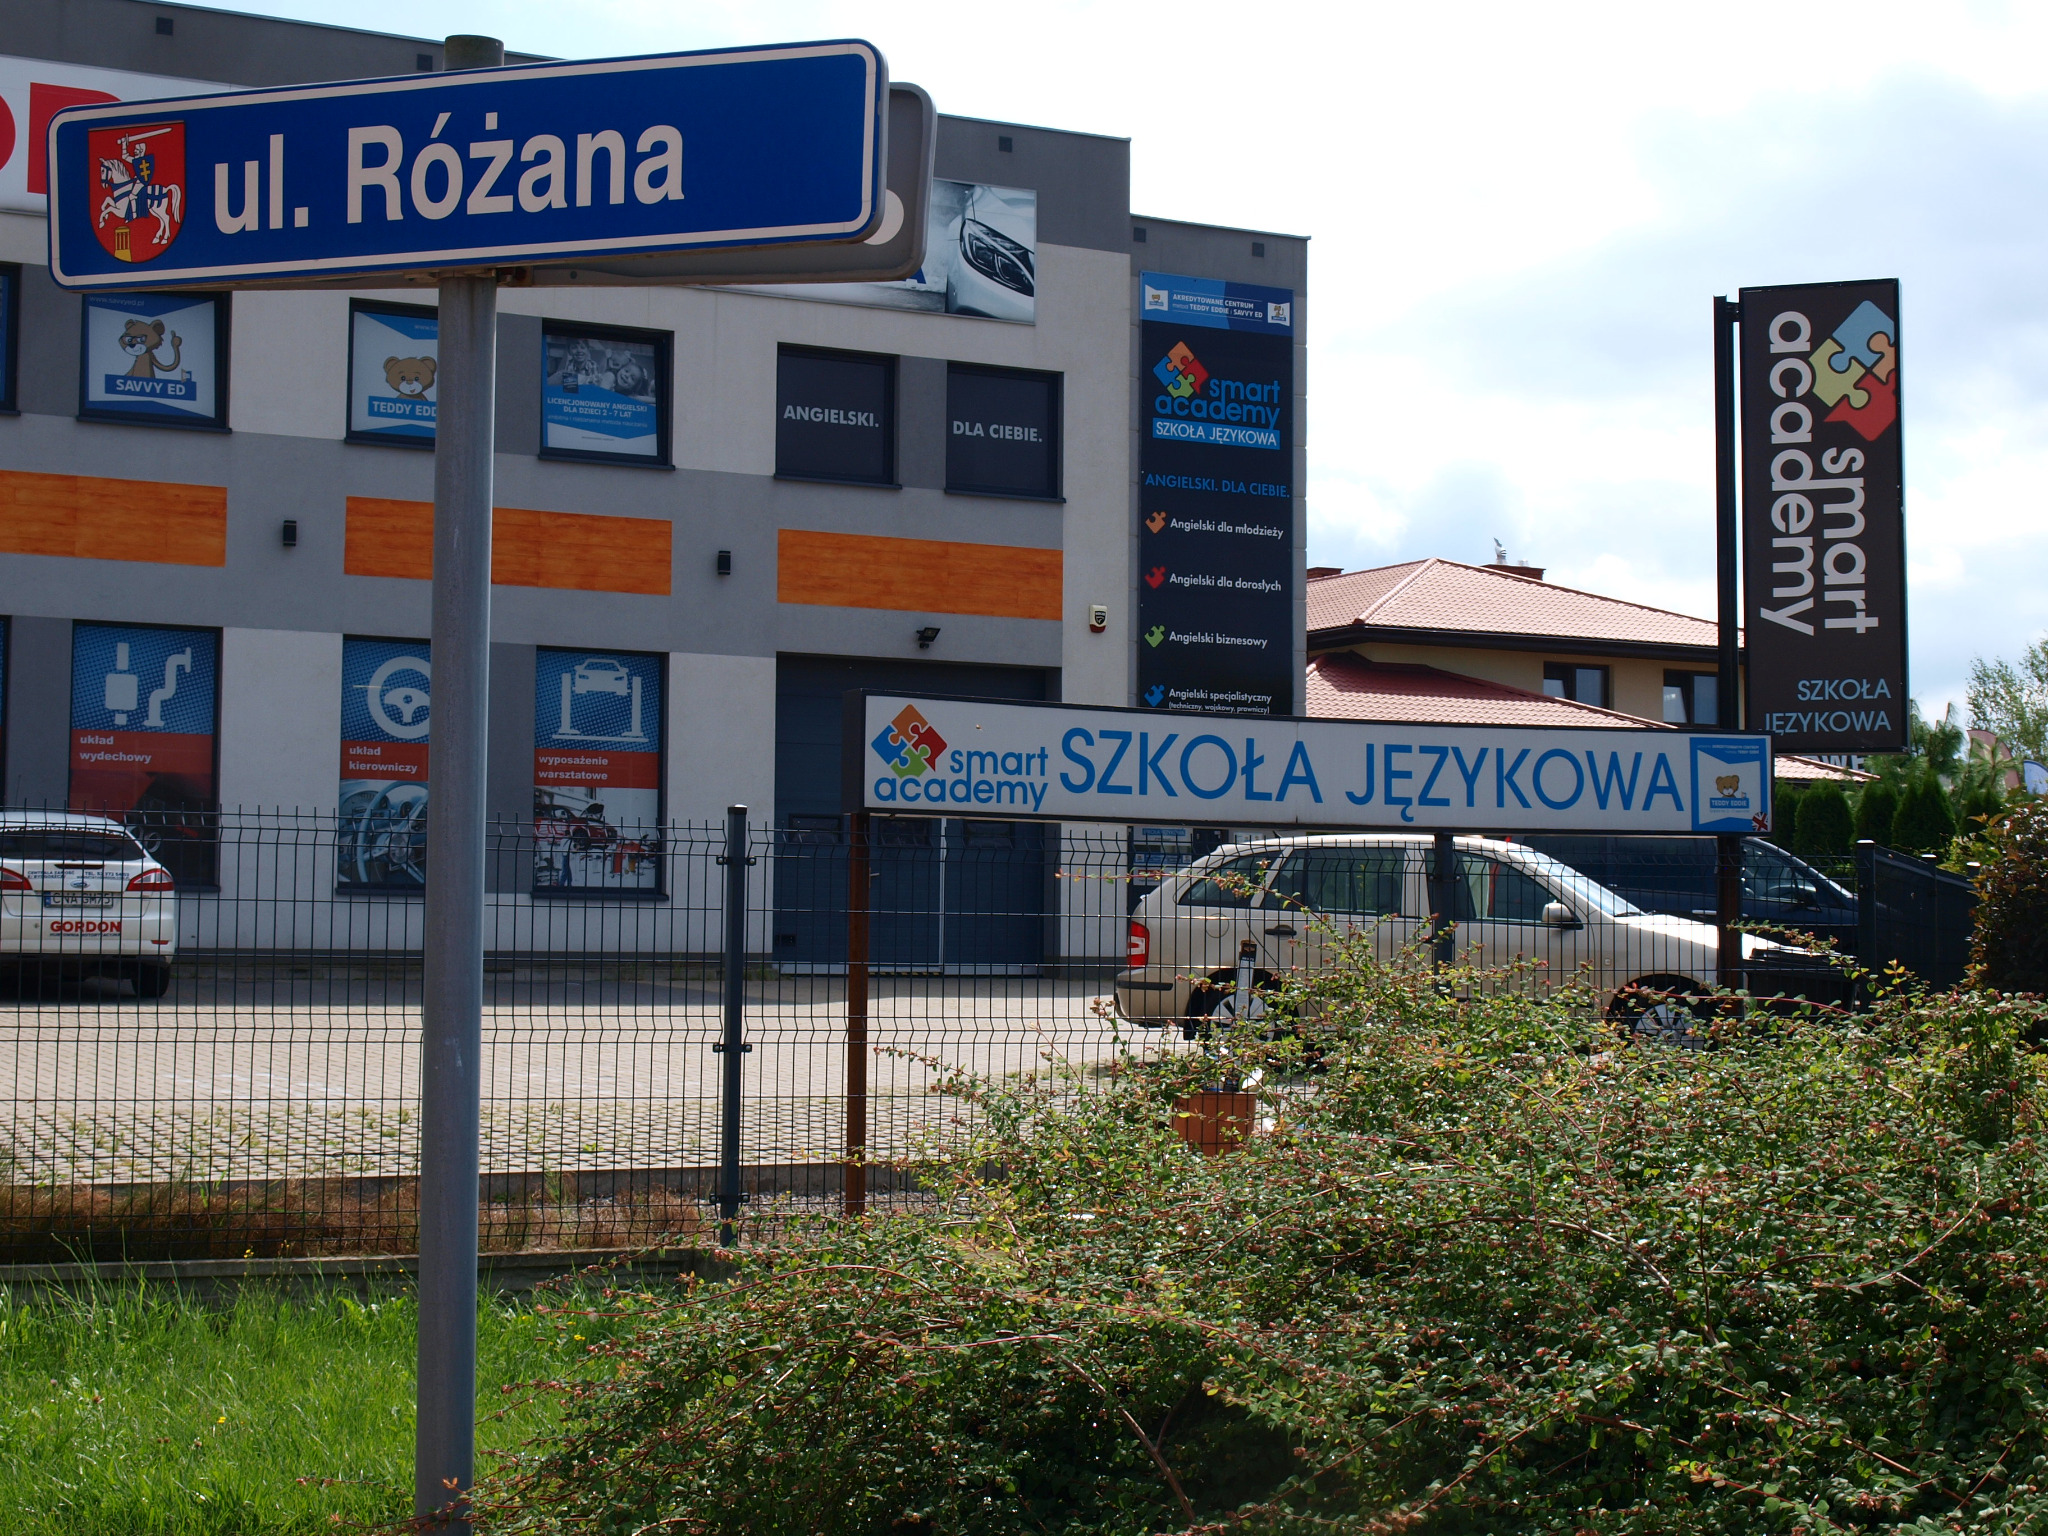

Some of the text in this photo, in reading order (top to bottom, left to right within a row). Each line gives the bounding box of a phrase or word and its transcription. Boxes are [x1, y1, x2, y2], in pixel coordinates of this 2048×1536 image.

[214, 134, 309, 234] ul.
[347, 112, 684, 223] Różana
[1172, 294, 1254, 310] AKREDYTOWANE CENTRUM
[1190, 304, 1209, 313] TEDDY
[1211, 306, 1229, 315] EDDIE
[1233, 309, 1254, 318] SAVVY
[1254, 311, 1263, 319] ED
[116, 379, 185, 396] SAVVY ED
[1209, 378, 1281, 404] smart
[372, 401, 412, 415] TEDDY
[547, 397, 647, 413] LICENCJONOWANY ANGIELSKI
[563, 406, 578, 414] DLA
[579, 408, 601, 416] DZIECI
[1154, 394, 1281, 430] academy
[783, 405, 880, 428] ANGIELSKI.
[953, 420, 1043, 443] DLA CIEBIE.
[1156, 421, 1277, 446] SZKOŁA JĘZYKOWA
[1760, 310, 1815, 636] academy
[1145, 473, 1290, 498] ANGIELSKI. DLA CIEBIE.
[1170, 518, 1284, 540] Angielski dla młodzieży
[1822, 447, 1879, 634] smart
[1169, 573, 1282, 593] Angielski dla dorosłych
[1169, 631, 1267, 649] Angielski biznesowy
[1168, 688, 1272, 705] Angielski specjalistyczny
[1797, 678, 1891, 701] SZKOŁA
[1168, 701, 1204, 711] (techniczny,
[1236, 705, 1270, 714] prawniczy)
[80, 735, 114, 745] układ
[79, 751, 152, 764] wydechowy
[349, 746, 381, 756] układ
[349, 761, 418, 774] kierowniczy
[538, 756, 609, 766] wyposażenie
[949, 746, 1049, 777] smart
[538, 770, 608, 780] warsztatowe
[1060, 727, 1685, 822] SZKOŁA JĘZYKOWA
[874, 775, 1049, 812] academy
[50, 921, 121, 932] GORDON
